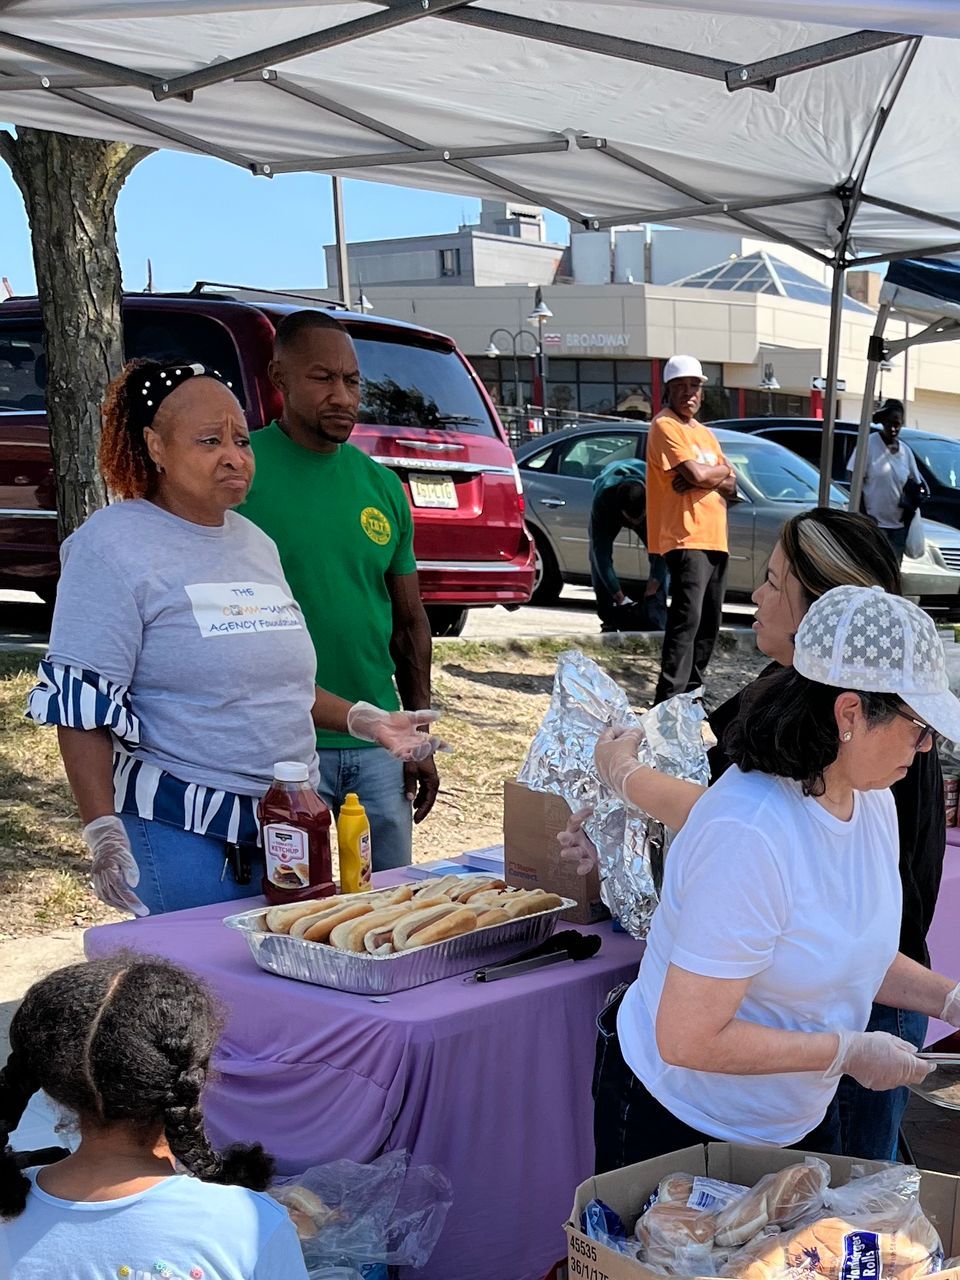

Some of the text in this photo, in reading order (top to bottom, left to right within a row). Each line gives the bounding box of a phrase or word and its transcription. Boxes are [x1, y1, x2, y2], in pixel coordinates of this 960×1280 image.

[566, 333, 631, 346] BROADWAY
[231, 588, 254, 597] THE
[209, 620, 257, 632] AGENCY
[271, 846, 299, 855] KETCHUP
[569, 1234, 598, 1263] 45535
[862, 1249, 877, 1277] Rolls
